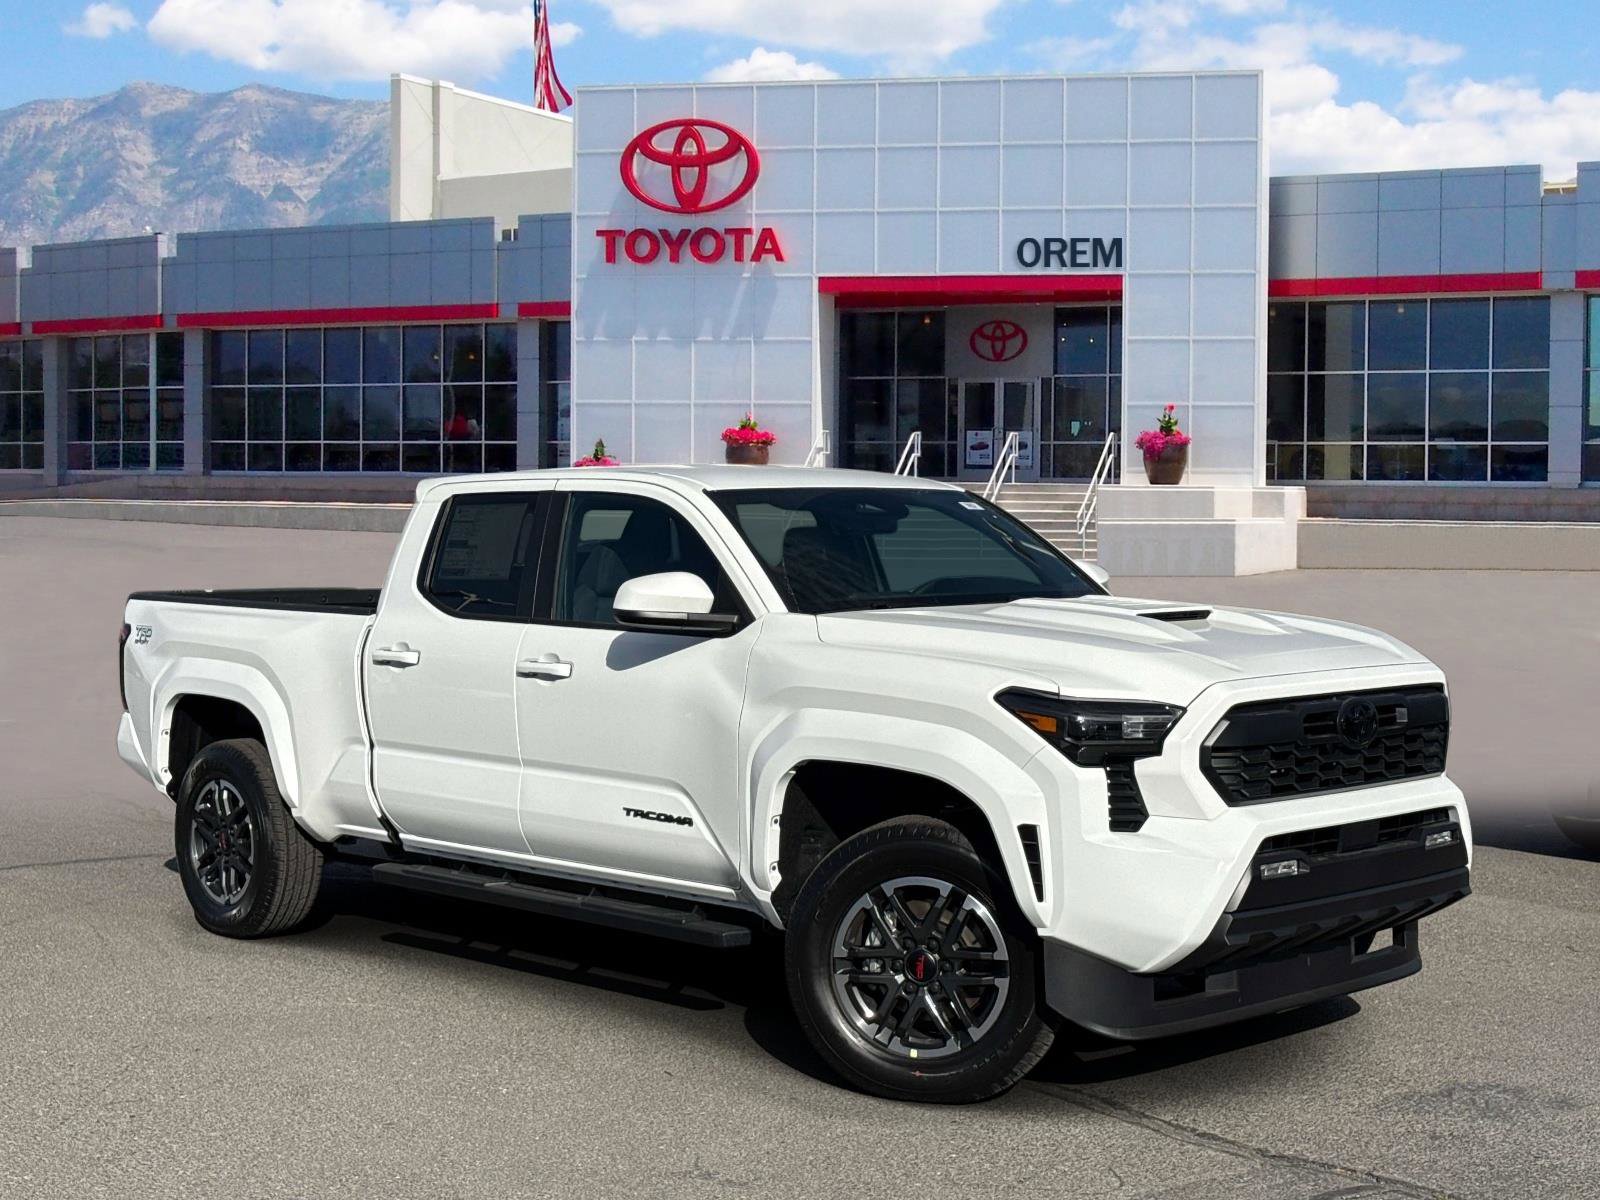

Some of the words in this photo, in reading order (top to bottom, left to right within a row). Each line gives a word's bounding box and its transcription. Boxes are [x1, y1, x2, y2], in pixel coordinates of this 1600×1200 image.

[595, 227, 785, 265] TOYOTA
[1016, 237, 1123, 268] OREM
[622, 806, 694, 827] TACOMA
